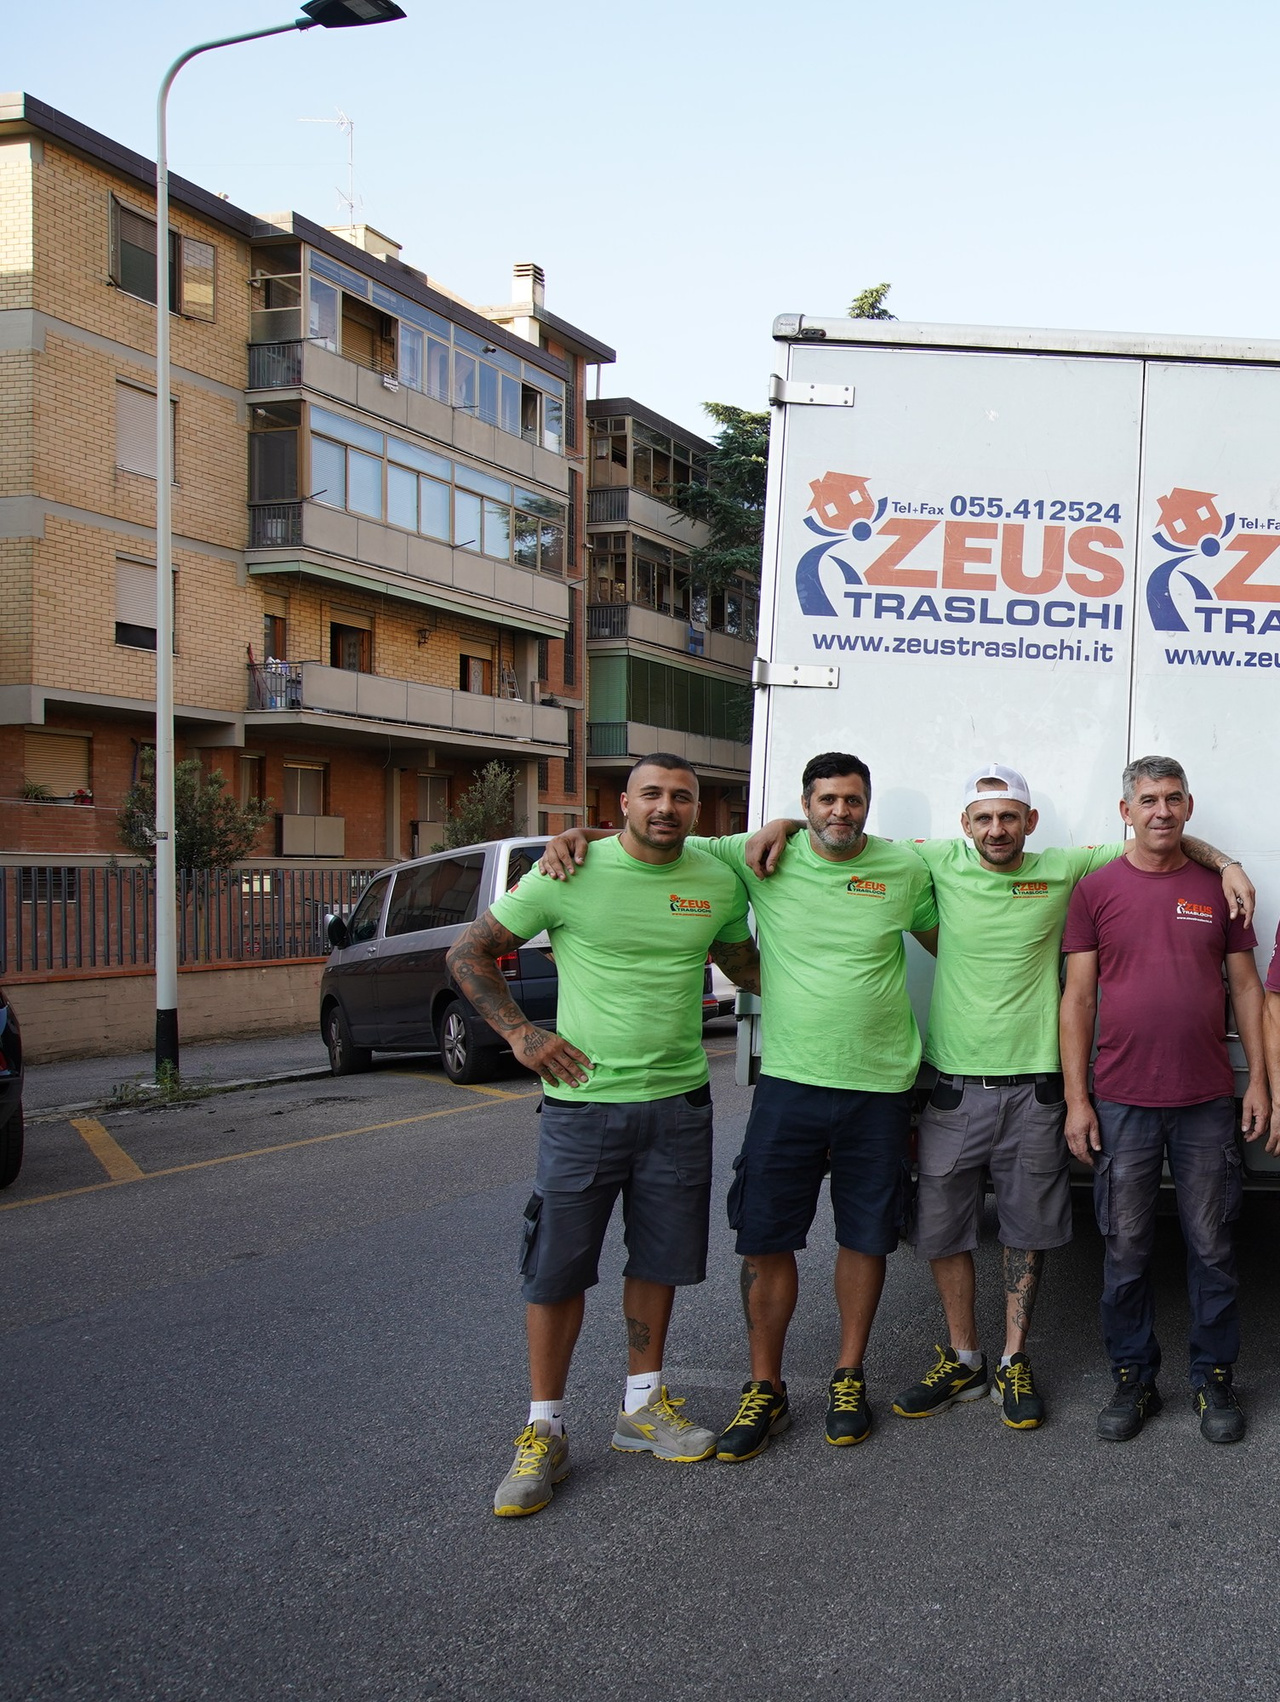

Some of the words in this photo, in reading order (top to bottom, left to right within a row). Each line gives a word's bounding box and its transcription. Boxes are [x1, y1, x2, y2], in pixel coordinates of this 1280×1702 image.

[949, 495, 1122, 524] 055.412524
[862, 517, 1125, 598] ZEUS
[843, 591, 1124, 631] TRASLOCHI
[812, 633, 1114, 663] www.zeustraslochi.it
[1020, 882, 1048, 891] ZEUS
[679, 899, 711, 909] ZEUS
[1185, 903, 1212, 914] ZEUS
